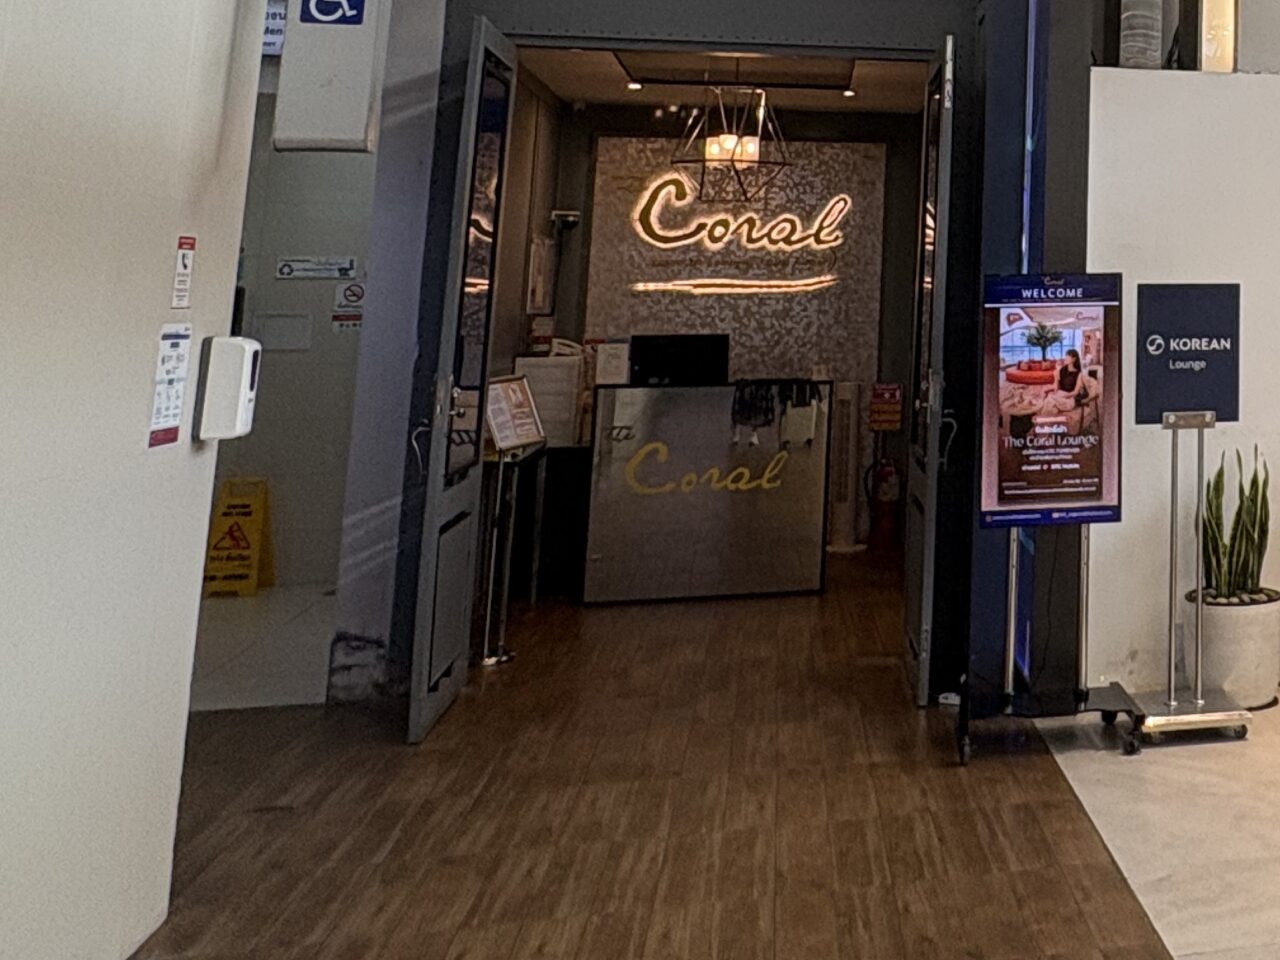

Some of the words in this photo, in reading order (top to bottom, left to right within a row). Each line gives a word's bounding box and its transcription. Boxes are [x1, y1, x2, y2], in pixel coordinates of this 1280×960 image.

[634, 172, 851, 250] Coral
[1021, 288, 1084, 299] WELCOME
[1169, 337, 1232, 351] KOREAN
[1169, 359, 1207, 371] Lounge
[1002, 435, 1025, 449] The
[1026, 434, 1056, 446] Coral
[1056, 434, 1100, 448] Lounge
[624, 441, 789, 495] Coral
